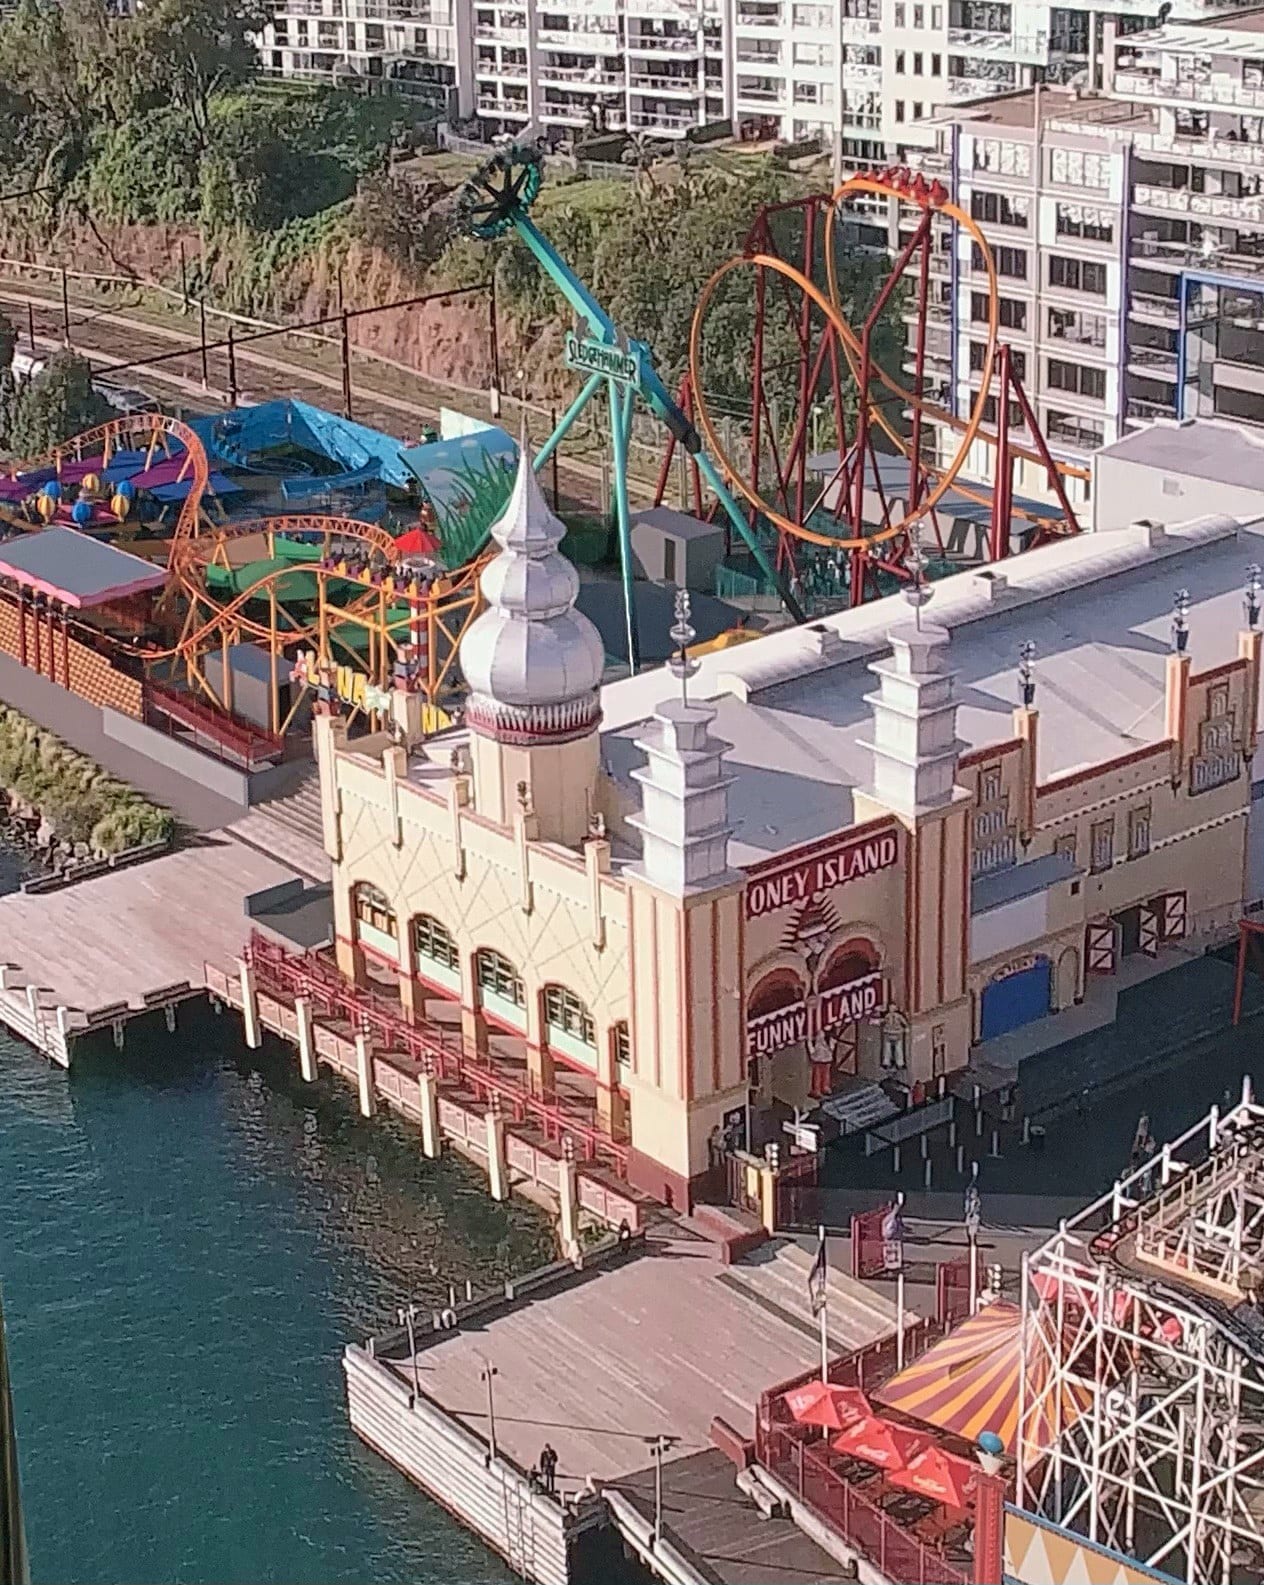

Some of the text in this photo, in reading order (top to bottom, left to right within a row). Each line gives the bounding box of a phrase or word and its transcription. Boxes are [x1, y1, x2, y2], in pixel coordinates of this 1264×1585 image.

[750, 837, 896, 913] ONEY ISLAND
[747, 988, 877, 1055] FUNNY LAND
